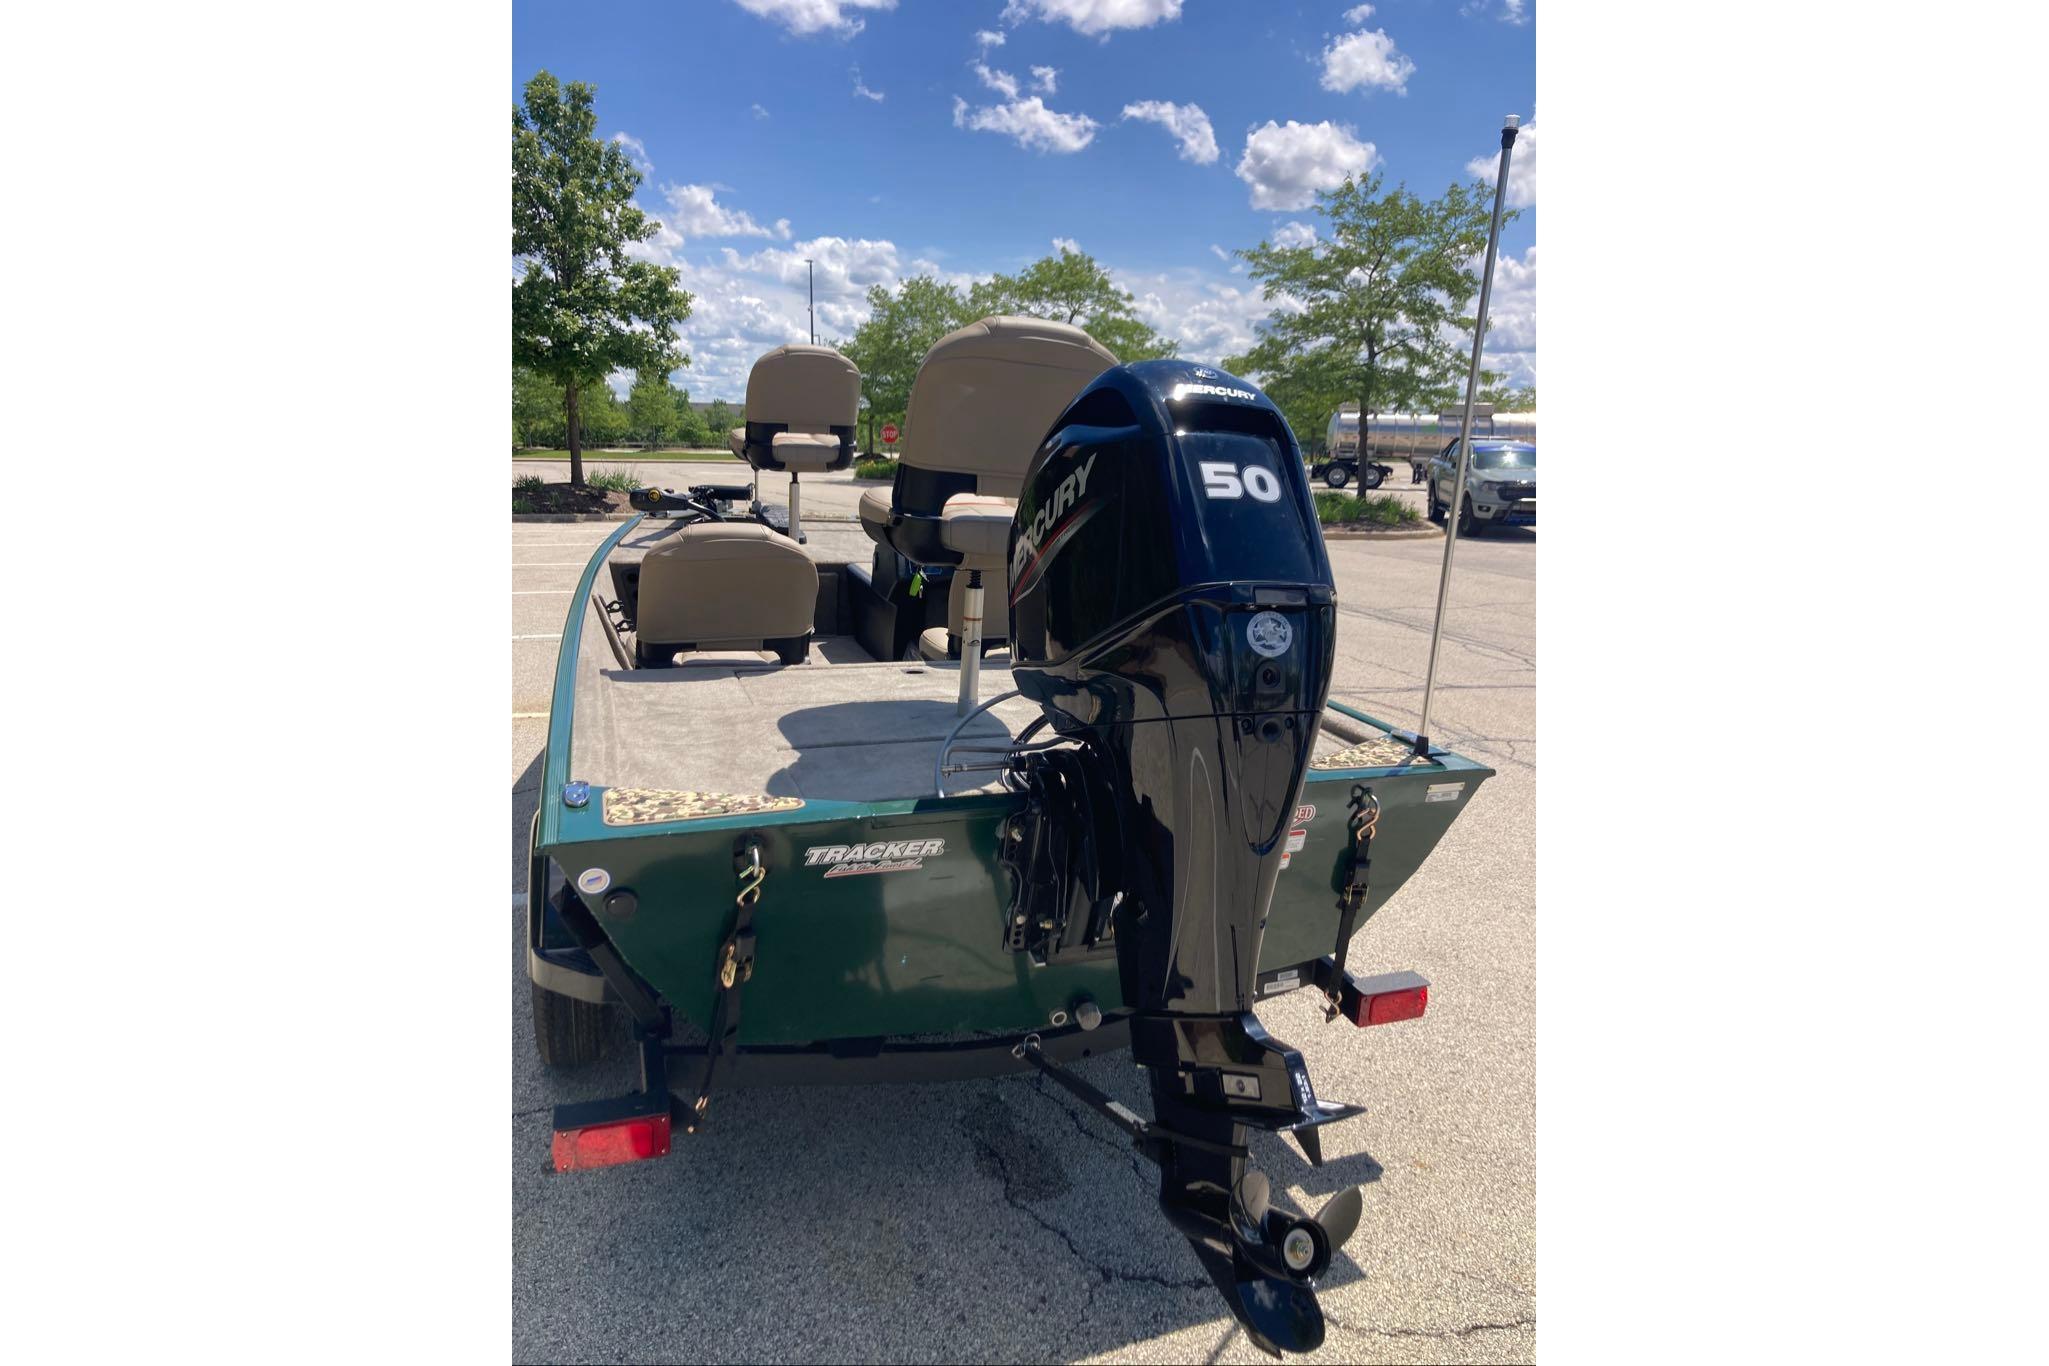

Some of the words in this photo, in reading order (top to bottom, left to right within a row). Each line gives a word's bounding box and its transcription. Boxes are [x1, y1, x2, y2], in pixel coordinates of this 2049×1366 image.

[1175, 384, 1256, 401] MERCURY
[881, 431, 897, 439] STOP
[1198, 461, 1281, 504] 50
[804, 838, 944, 866] TRACKER
